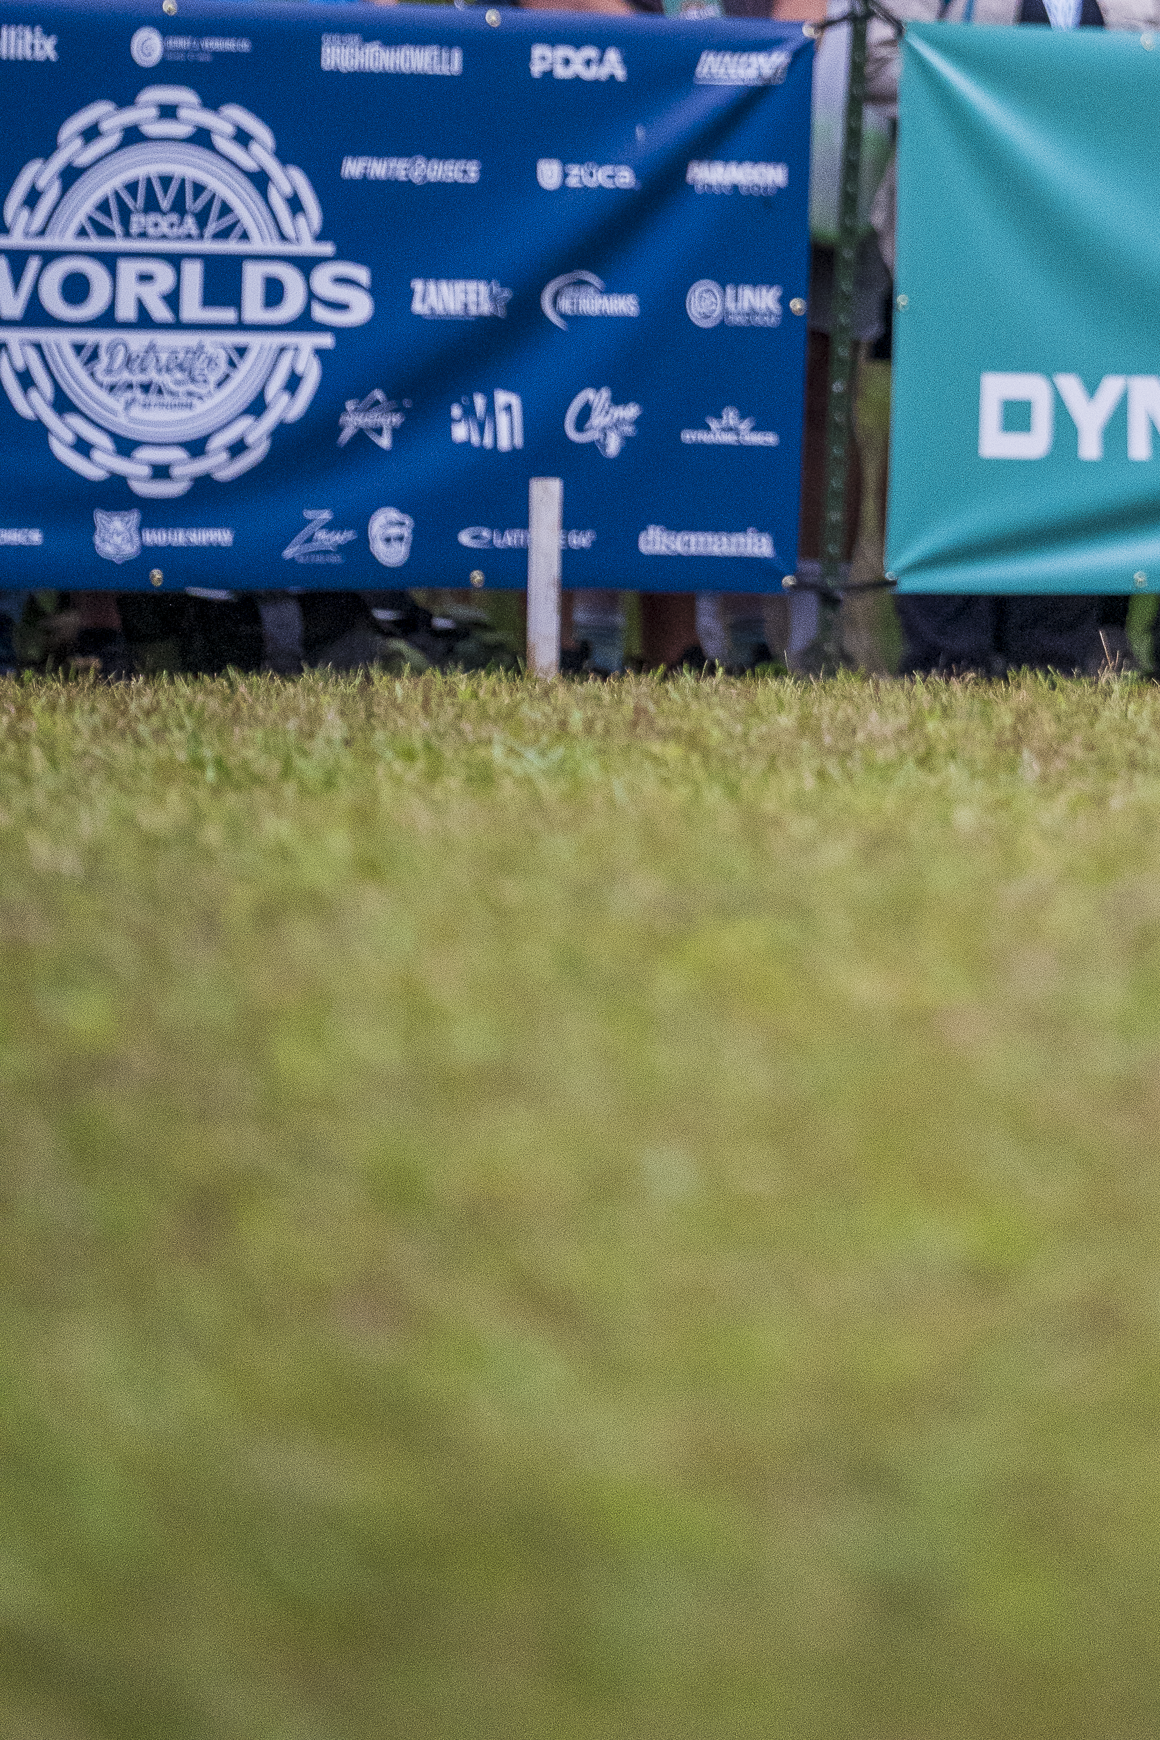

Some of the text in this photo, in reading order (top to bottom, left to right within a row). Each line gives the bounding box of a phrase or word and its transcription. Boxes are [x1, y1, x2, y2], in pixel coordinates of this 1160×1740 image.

[530, 43, 627, 81] PDGA
[725, 283, 783, 311] LINK
[638, 524, 774, 558] discmania
